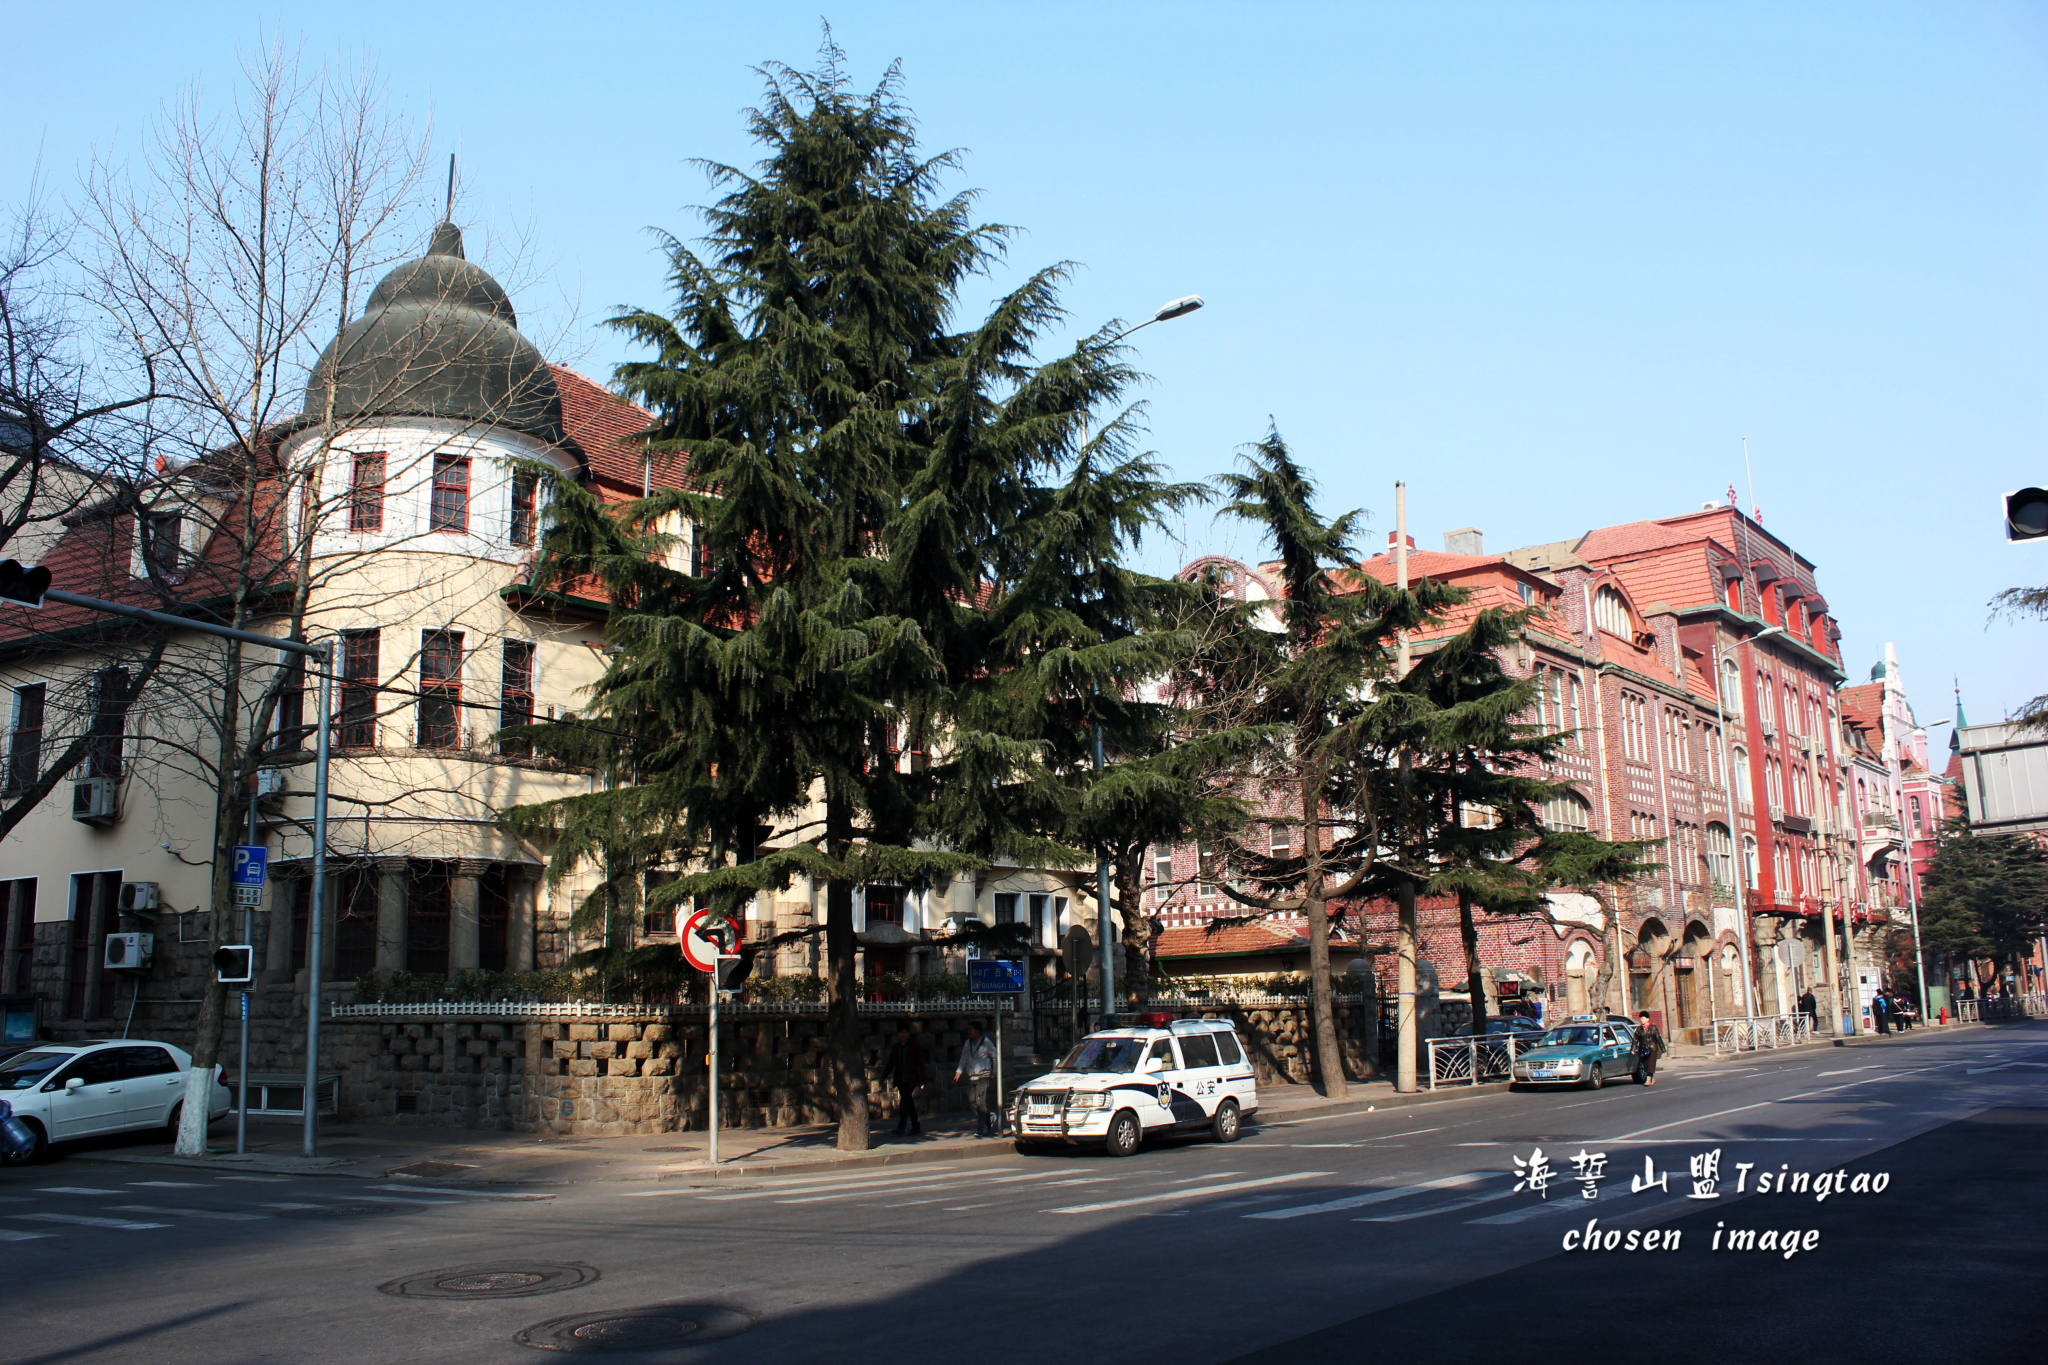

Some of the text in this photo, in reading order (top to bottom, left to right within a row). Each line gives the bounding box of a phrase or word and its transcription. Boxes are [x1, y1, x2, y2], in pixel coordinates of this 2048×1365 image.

[234, 850, 250, 872] P
[983, 968, 1013, 978] 广西路
[1196, 1080, 1216, 1096] 公安
